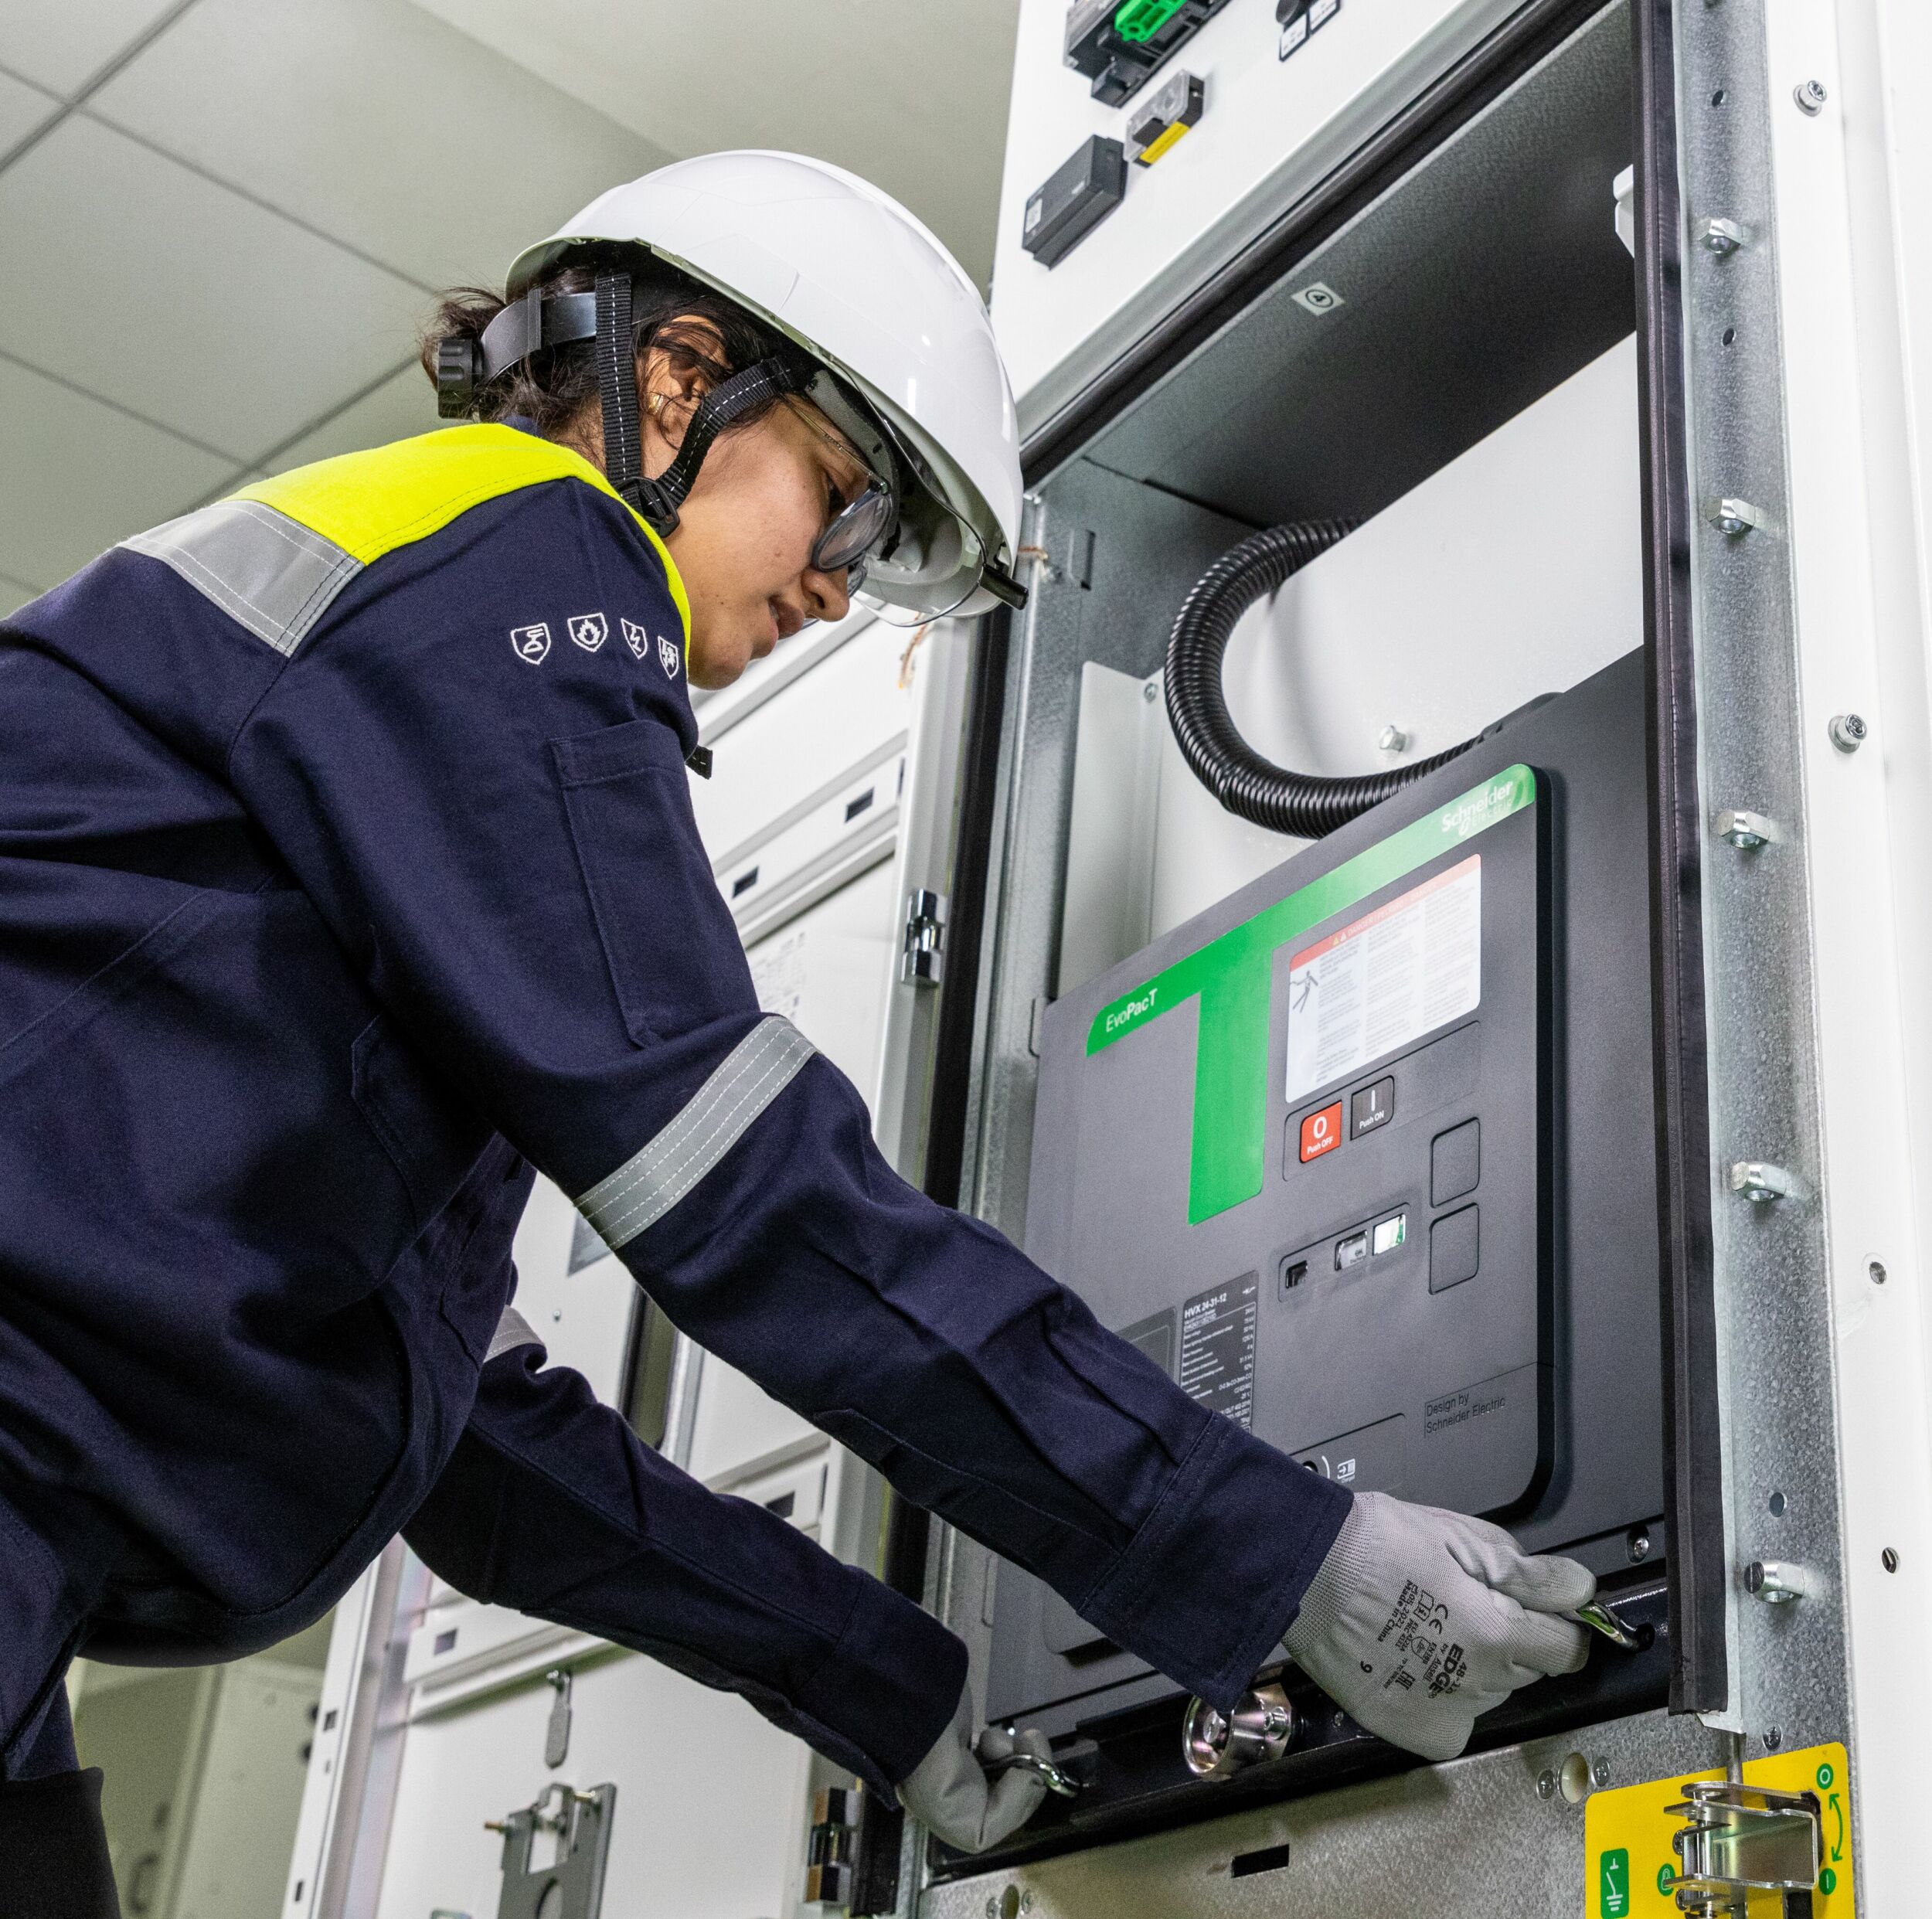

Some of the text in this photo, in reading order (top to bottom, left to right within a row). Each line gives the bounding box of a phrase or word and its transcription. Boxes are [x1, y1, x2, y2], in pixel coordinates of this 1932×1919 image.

[1442, 780, 1513, 832] Schneider
[1471, 798, 1512, 827] Electric
[1106, 988, 1158, 1033] EvoPacT
[1359, 1110, 1384, 1129] Push ON
[1307, 1135, 1333, 1155] Push OFF
[1184, 1304, 1202, 1318] HVX
[1427, 1393, 1469, 1417] Design by
[1427, 1397, 1505, 1434] Schneider Electric
[1377, 1579, 1413, 1642] Made in China
[1424, 1643, 1449, 1682] by Ansell
